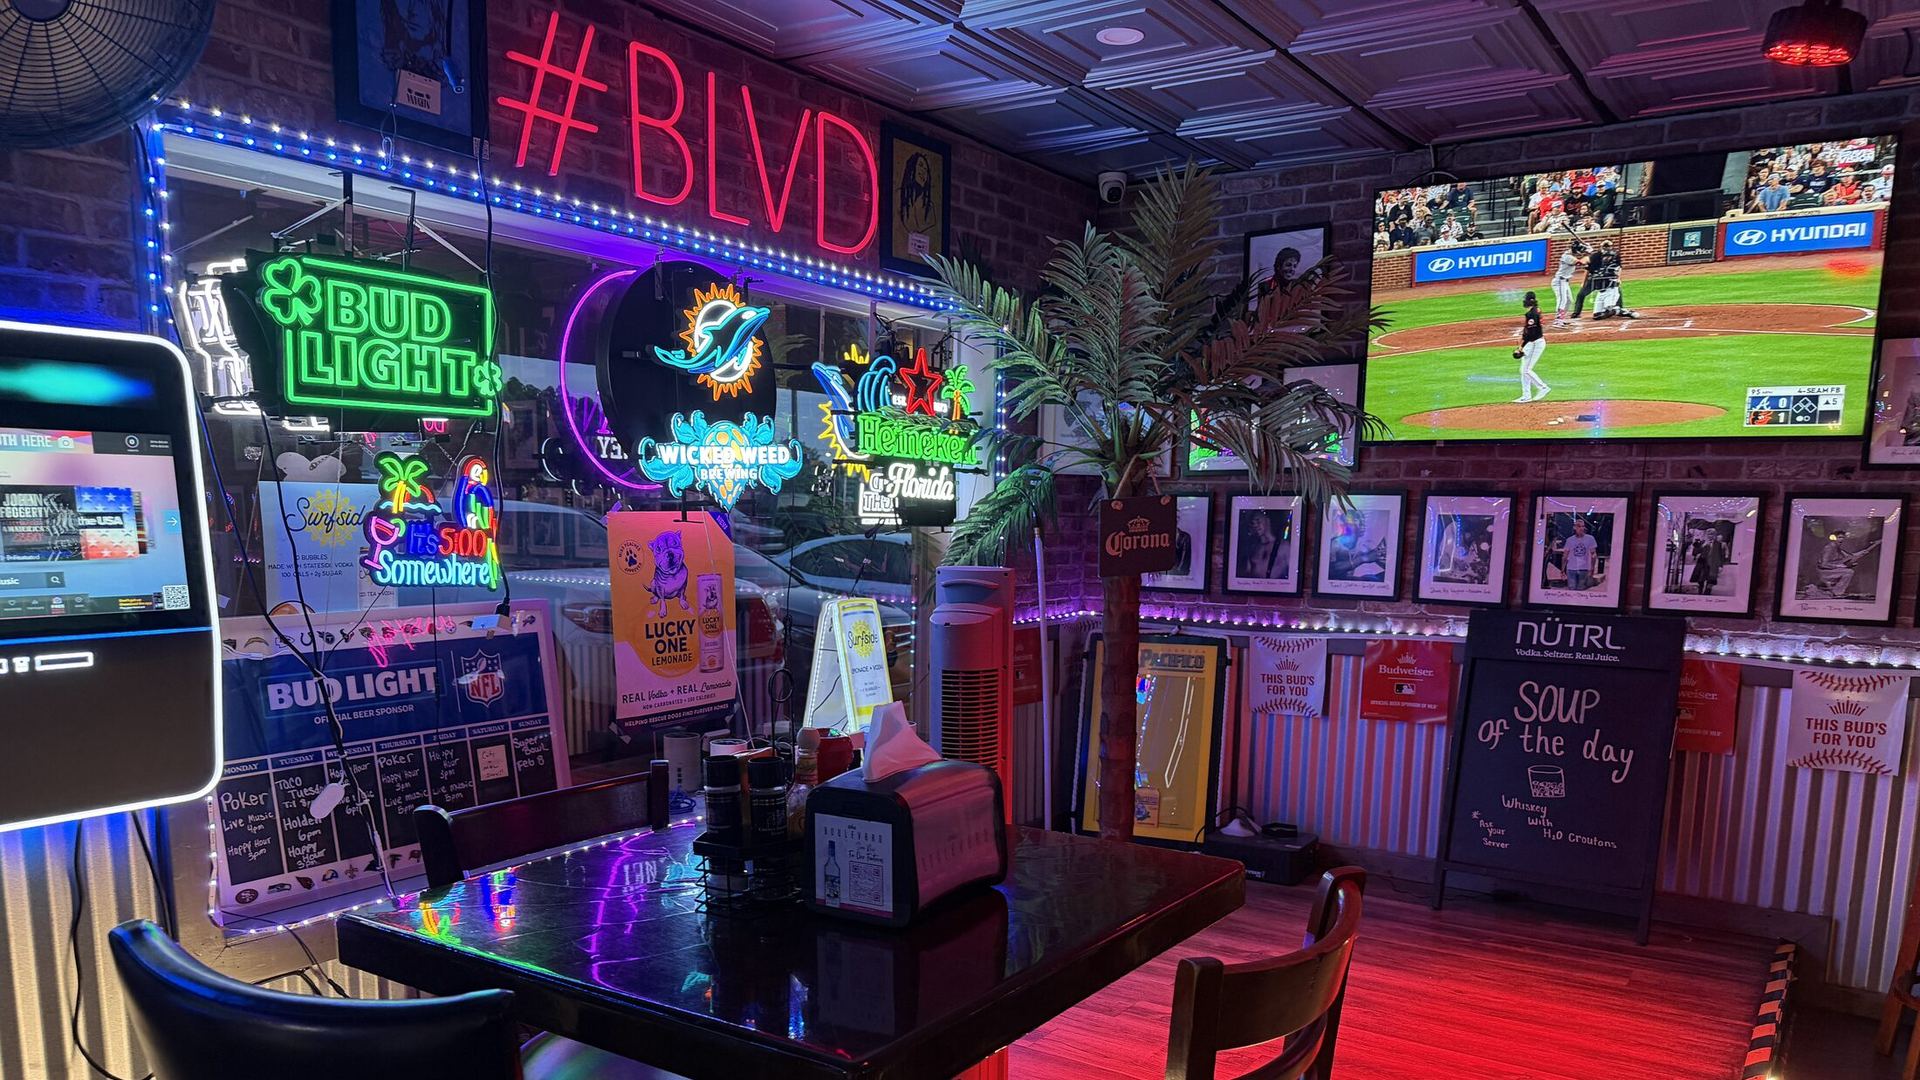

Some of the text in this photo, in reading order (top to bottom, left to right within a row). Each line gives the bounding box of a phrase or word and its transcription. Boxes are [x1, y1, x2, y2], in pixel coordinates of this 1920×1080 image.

[497, 11, 879, 254] #BLVD
[1770, 223, 1866, 242] HYUNDAI
[1458, 250, 1532, 269] HYUNDAI
[327, 280, 450, 343] BUD
[301, 331, 477, 396] LIGHT
[1778, 398, 1787, 409] 0
[1777, 412, 1785, 423] 1
[21, 435, 53, 448] HERE
[857, 414, 978, 465] Heineken
[659, 445, 790, 465] WICKED WEED
[700, 467, 757, 480] BREWING
[888, 463, 954, 500] Florida
[97, 516, 123, 525] USA
[285, 497, 365, 533] Surfsid
[439, 528, 487, 557] 5:00
[1105, 531, 1170, 558] Corona
[376, 550, 490, 585] Somewhere
[645, 619, 695, 640] LUCKY
[702, 617, 720, 625] LUCKY
[654, 637, 689, 654] ONE
[652, 653, 693, 666] LEMONADE
[1575, 652, 1594, 661] Real
[267, 666, 438, 711] BUD LIGHT
[470, 674, 500, 698] NFL
[1261, 673, 1315, 686] THIS BUD'S
[622, 692, 645, 704] REAL
[648, 690, 668, 700] Vodka
[677, 684, 698, 695] REAL
[701, 680, 732, 693] Lemonade
[1266, 685, 1309, 697] FOR YOU
[1514, 680, 1600, 724] SOUP
[353, 708, 374, 720] BEER
[375, 704, 415, 718] SPONSOR
[1806, 718, 1887, 735] THIS BUD'S
[224, 764, 259, 775] MONDAY
[279, 754, 314, 765] TUESDAY
[380, 738, 417, 749] THURSDAY
[472, 725, 505, 735] SATURDAY
[519, 718, 542, 728] SUNDAY
[513, 736, 539, 749] Super
[1813, 733, 1876, 749] FOR YOU
[1519, 724, 1564, 757] the
[1582, 729, 1634, 784] day
[1501, 795, 1548, 818] Whiskey
[223, 817, 245, 832] Live
[298, 828, 322, 841] 6pm
